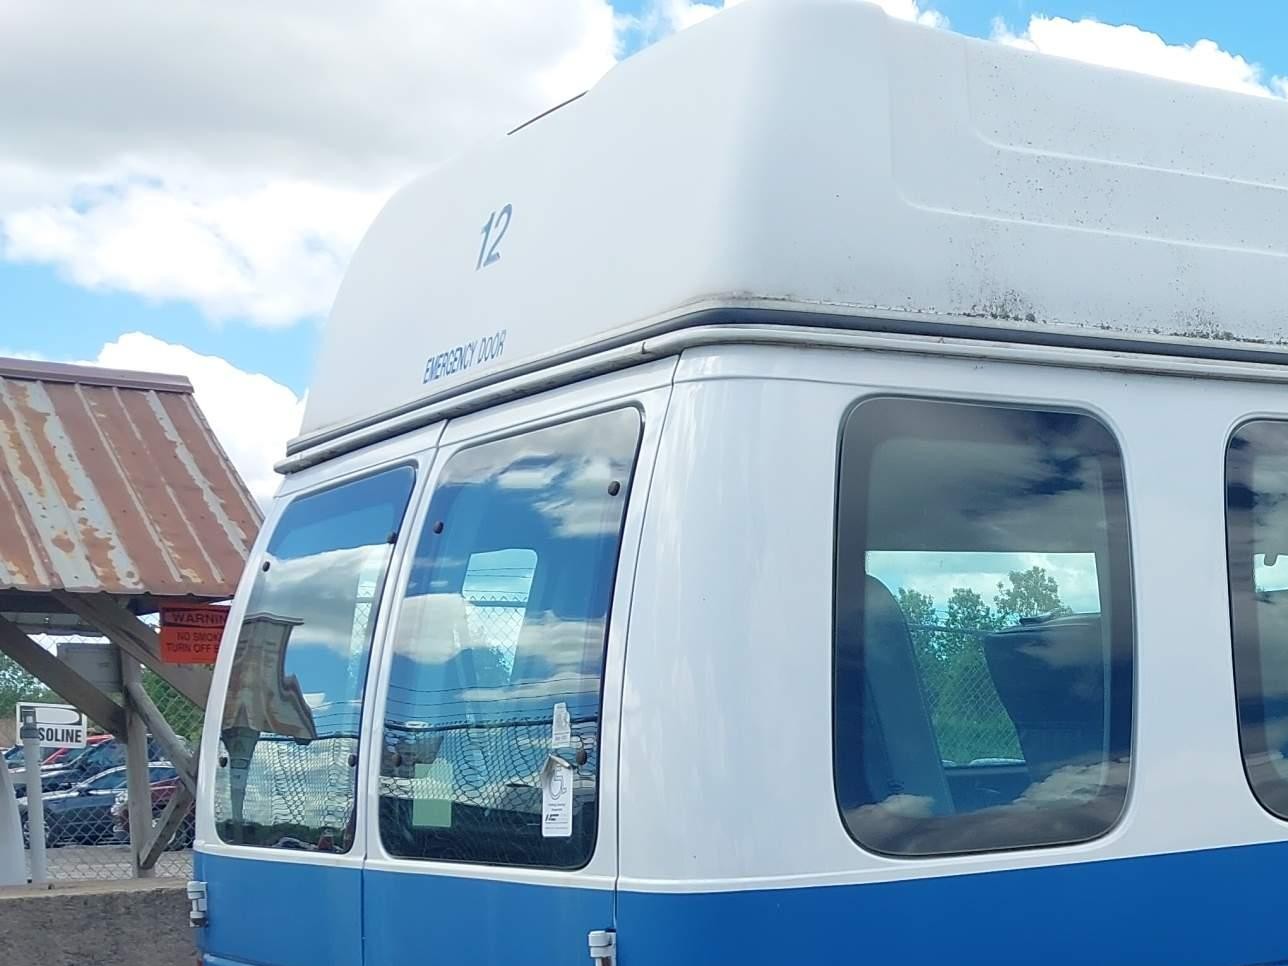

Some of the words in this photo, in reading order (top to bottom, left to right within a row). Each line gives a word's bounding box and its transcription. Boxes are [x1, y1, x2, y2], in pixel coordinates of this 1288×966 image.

[476, 203, 513, 271] 12
[423, 341, 479, 385] EMERGENCY
[477, 329, 507, 364] DOOR
[176, 631, 191, 641] NO
[193, 642, 212, 654] OFF
[38, 727, 82, 743] SOLINE
